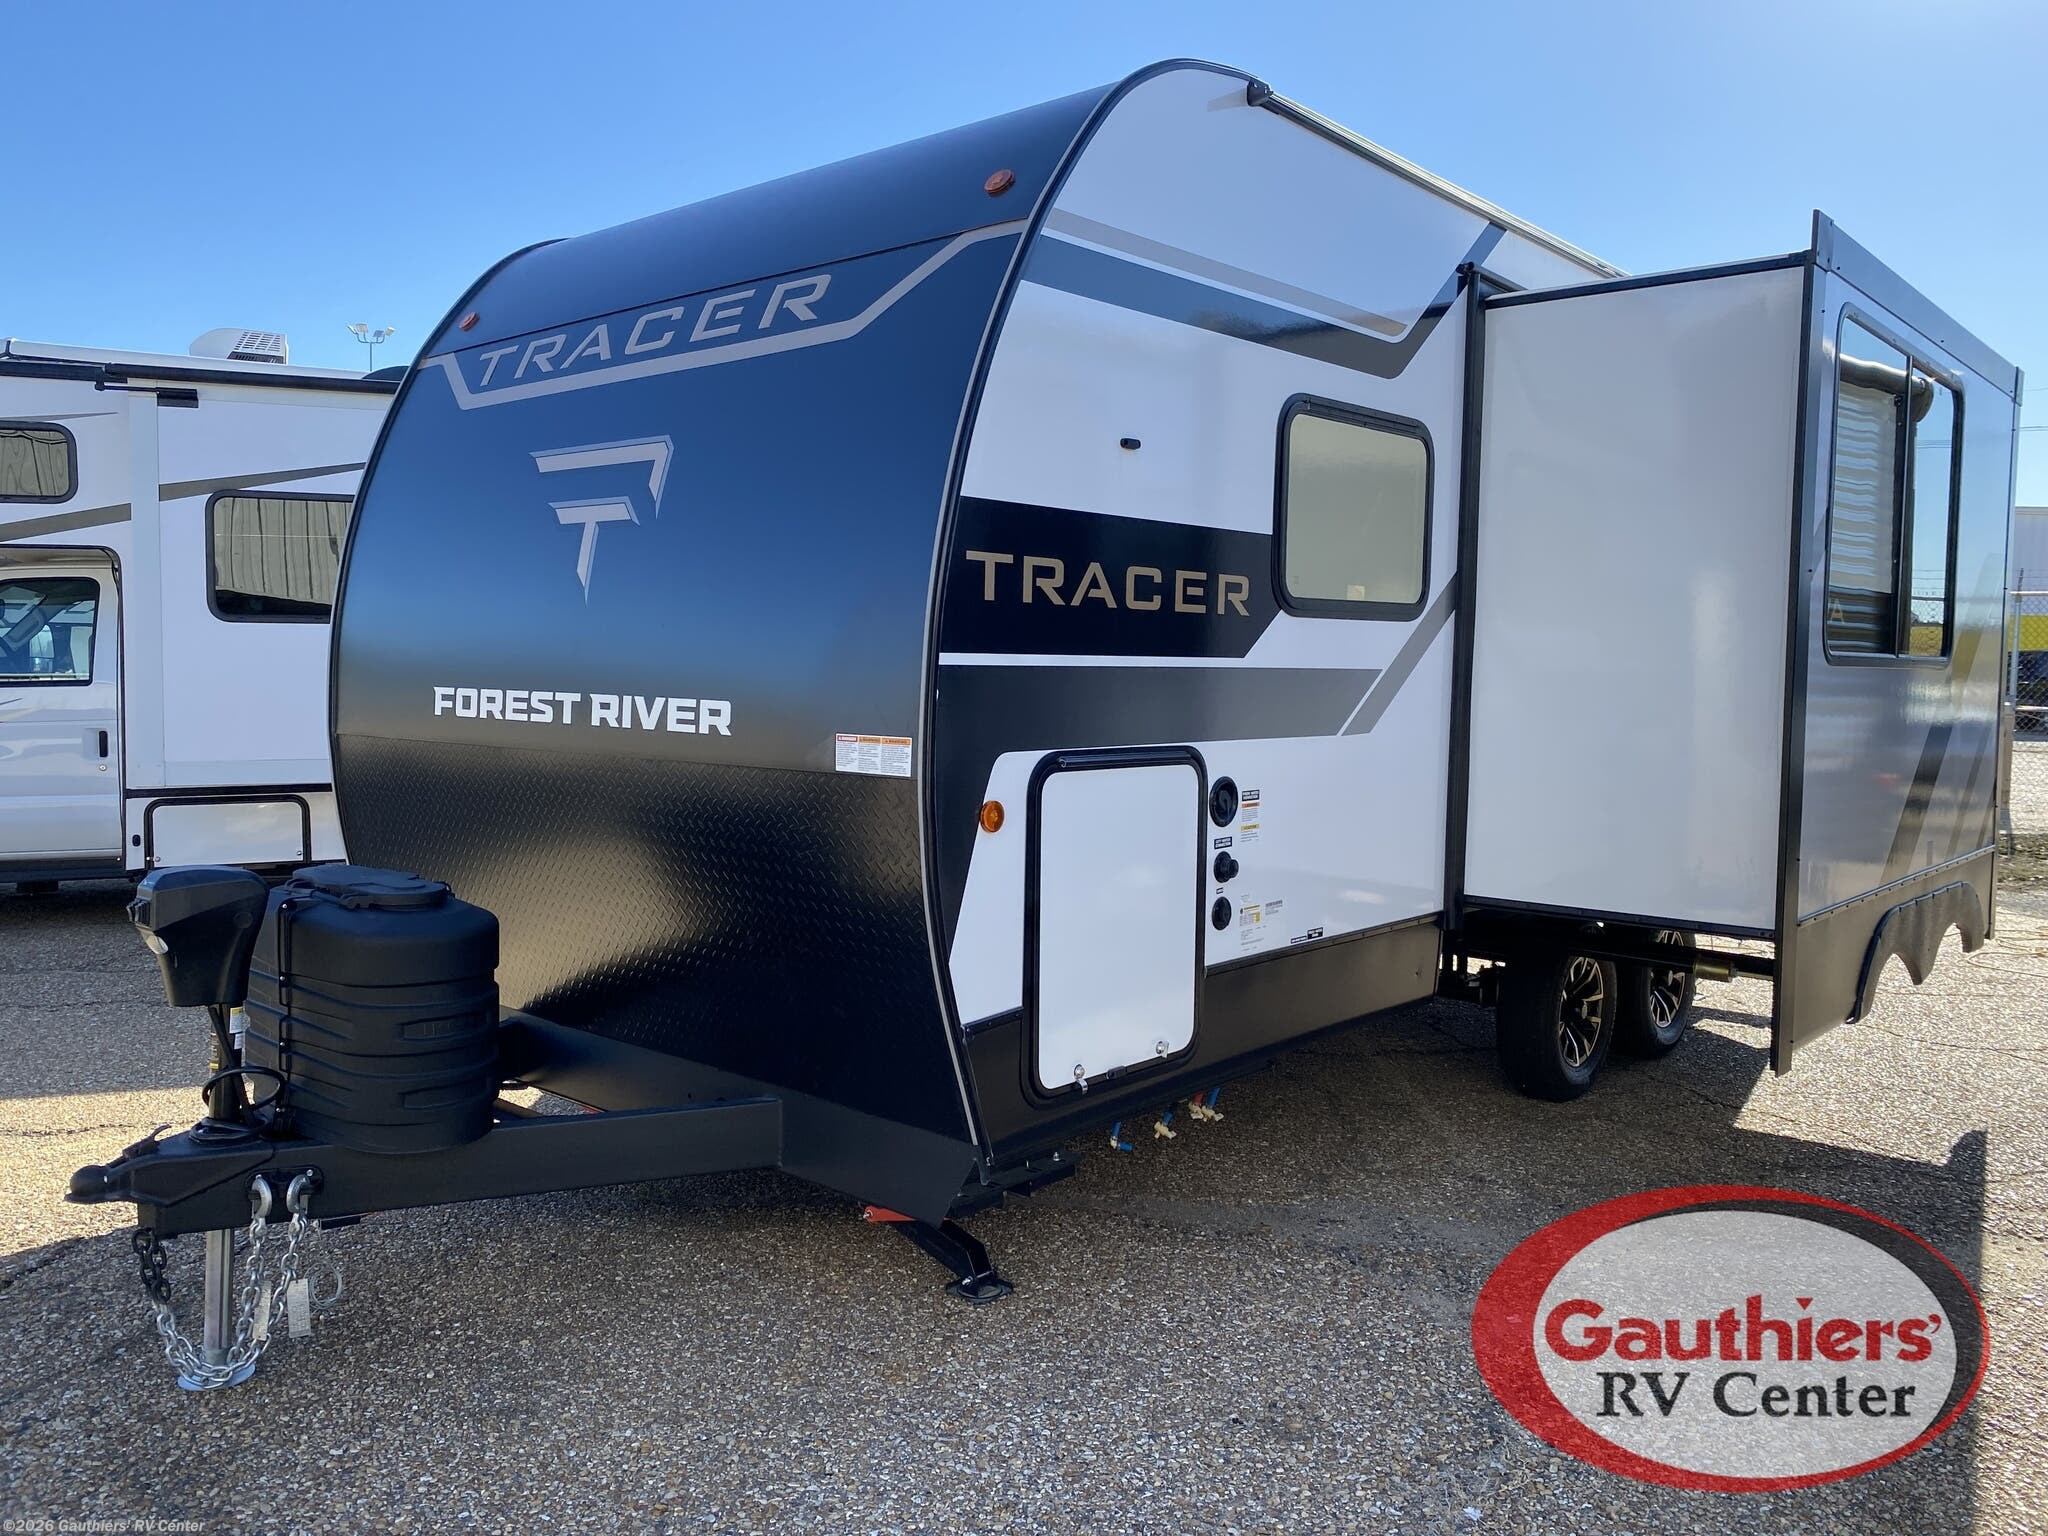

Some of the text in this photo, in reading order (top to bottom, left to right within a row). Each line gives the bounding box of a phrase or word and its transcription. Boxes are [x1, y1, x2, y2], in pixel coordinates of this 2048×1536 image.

[479, 274, 831, 387] TRACER
[965, 549, 1250, 616] TRACER
[433, 686, 733, 736] FOREST RIVER
